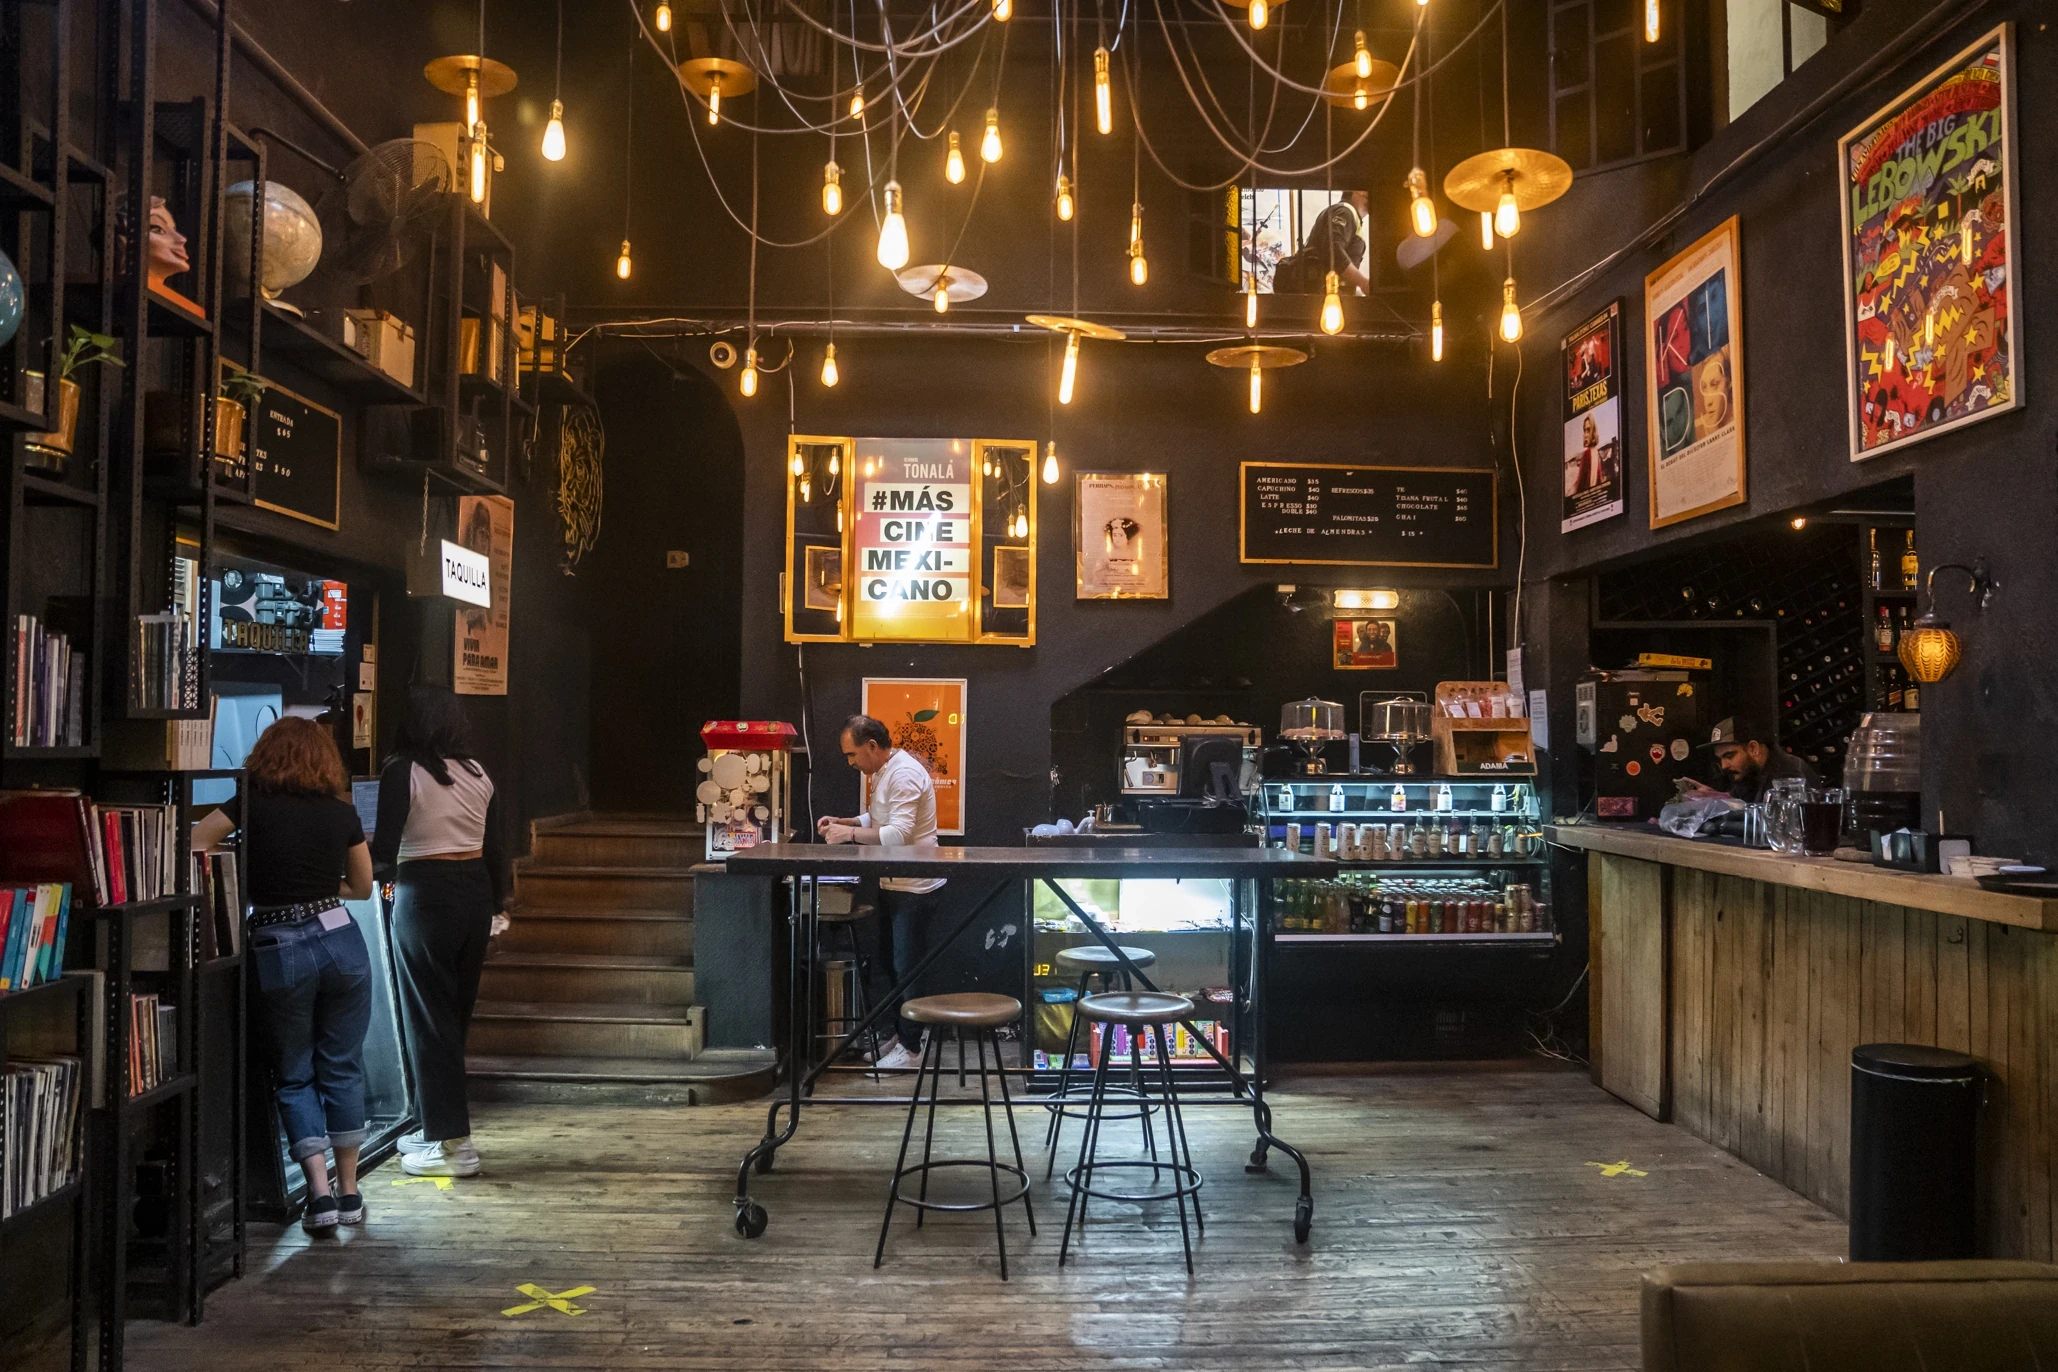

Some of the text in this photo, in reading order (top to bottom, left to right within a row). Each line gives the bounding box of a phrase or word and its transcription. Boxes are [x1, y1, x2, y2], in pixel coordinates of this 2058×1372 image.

[1895, 114, 1956, 160] THE BIG
[1852, 104, 2003, 230] LEBOWSKI
[269, 409, 294, 428] ENTRADA
[903, 460, 955, 479] TONALÁ
[872, 486, 954, 511] #MÁS
[884, 520, 954, 542] CINE
[867, 550, 953, 571] MEXI-
[445, 557, 487, 590] TAQUILLA
[867, 579, 953, 601] CANO
[223, 618, 309, 655] TAQUILLA
[1480, 762, 1508, 770] ADAMÁ
